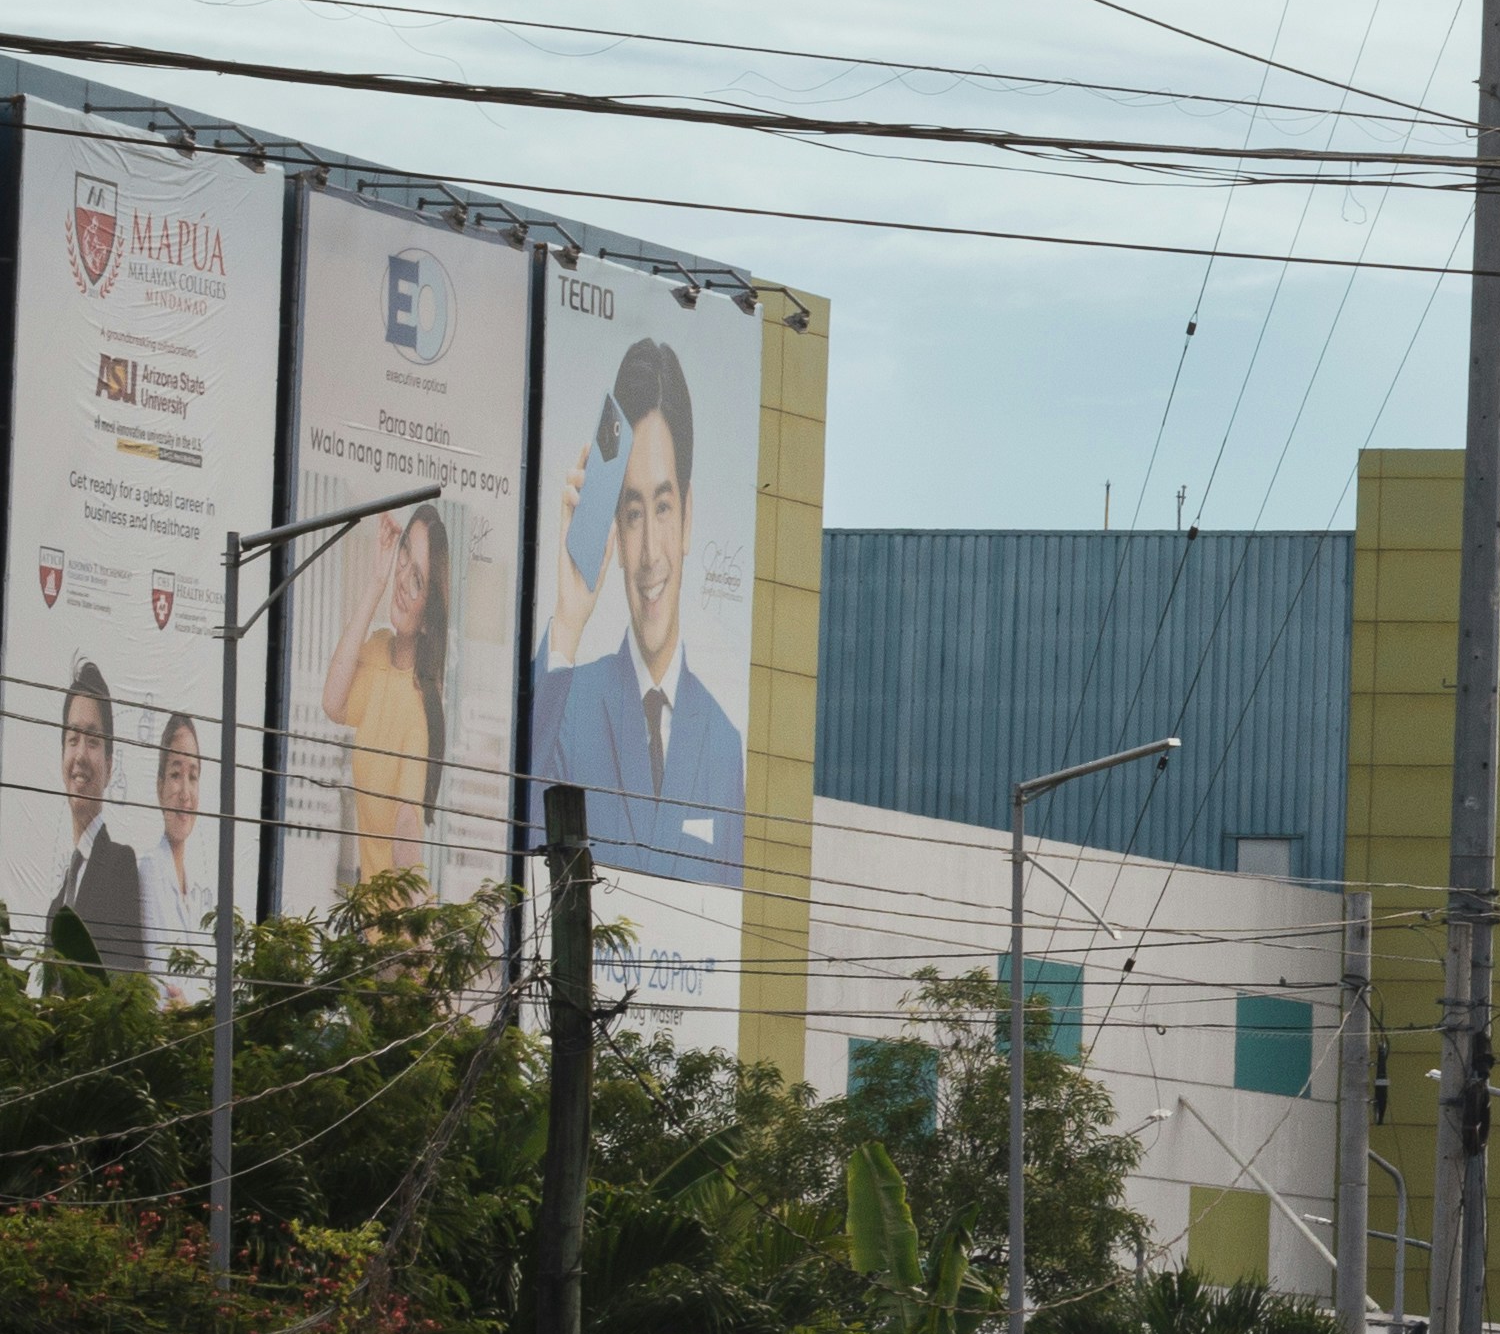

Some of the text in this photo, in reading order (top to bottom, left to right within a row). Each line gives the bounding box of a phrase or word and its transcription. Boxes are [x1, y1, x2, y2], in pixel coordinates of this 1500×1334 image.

[131, 205, 227, 276] MAPÚA
[127, 261, 227, 301] MALAYAN COLLEGES
[558, 275, 614, 320] TECNO
[144, 289, 208, 317] MINDANAO
[141, 364, 206, 397] Arizona State
[140, 388, 190, 420] University
[379, 409, 450, 448] Para sa akin
[310, 426, 511, 497] Wala nang mas hihigit pa sayo.
[69, 470, 216, 517] Get ready for a global career in
[84, 499, 201, 541] business and healthcare
